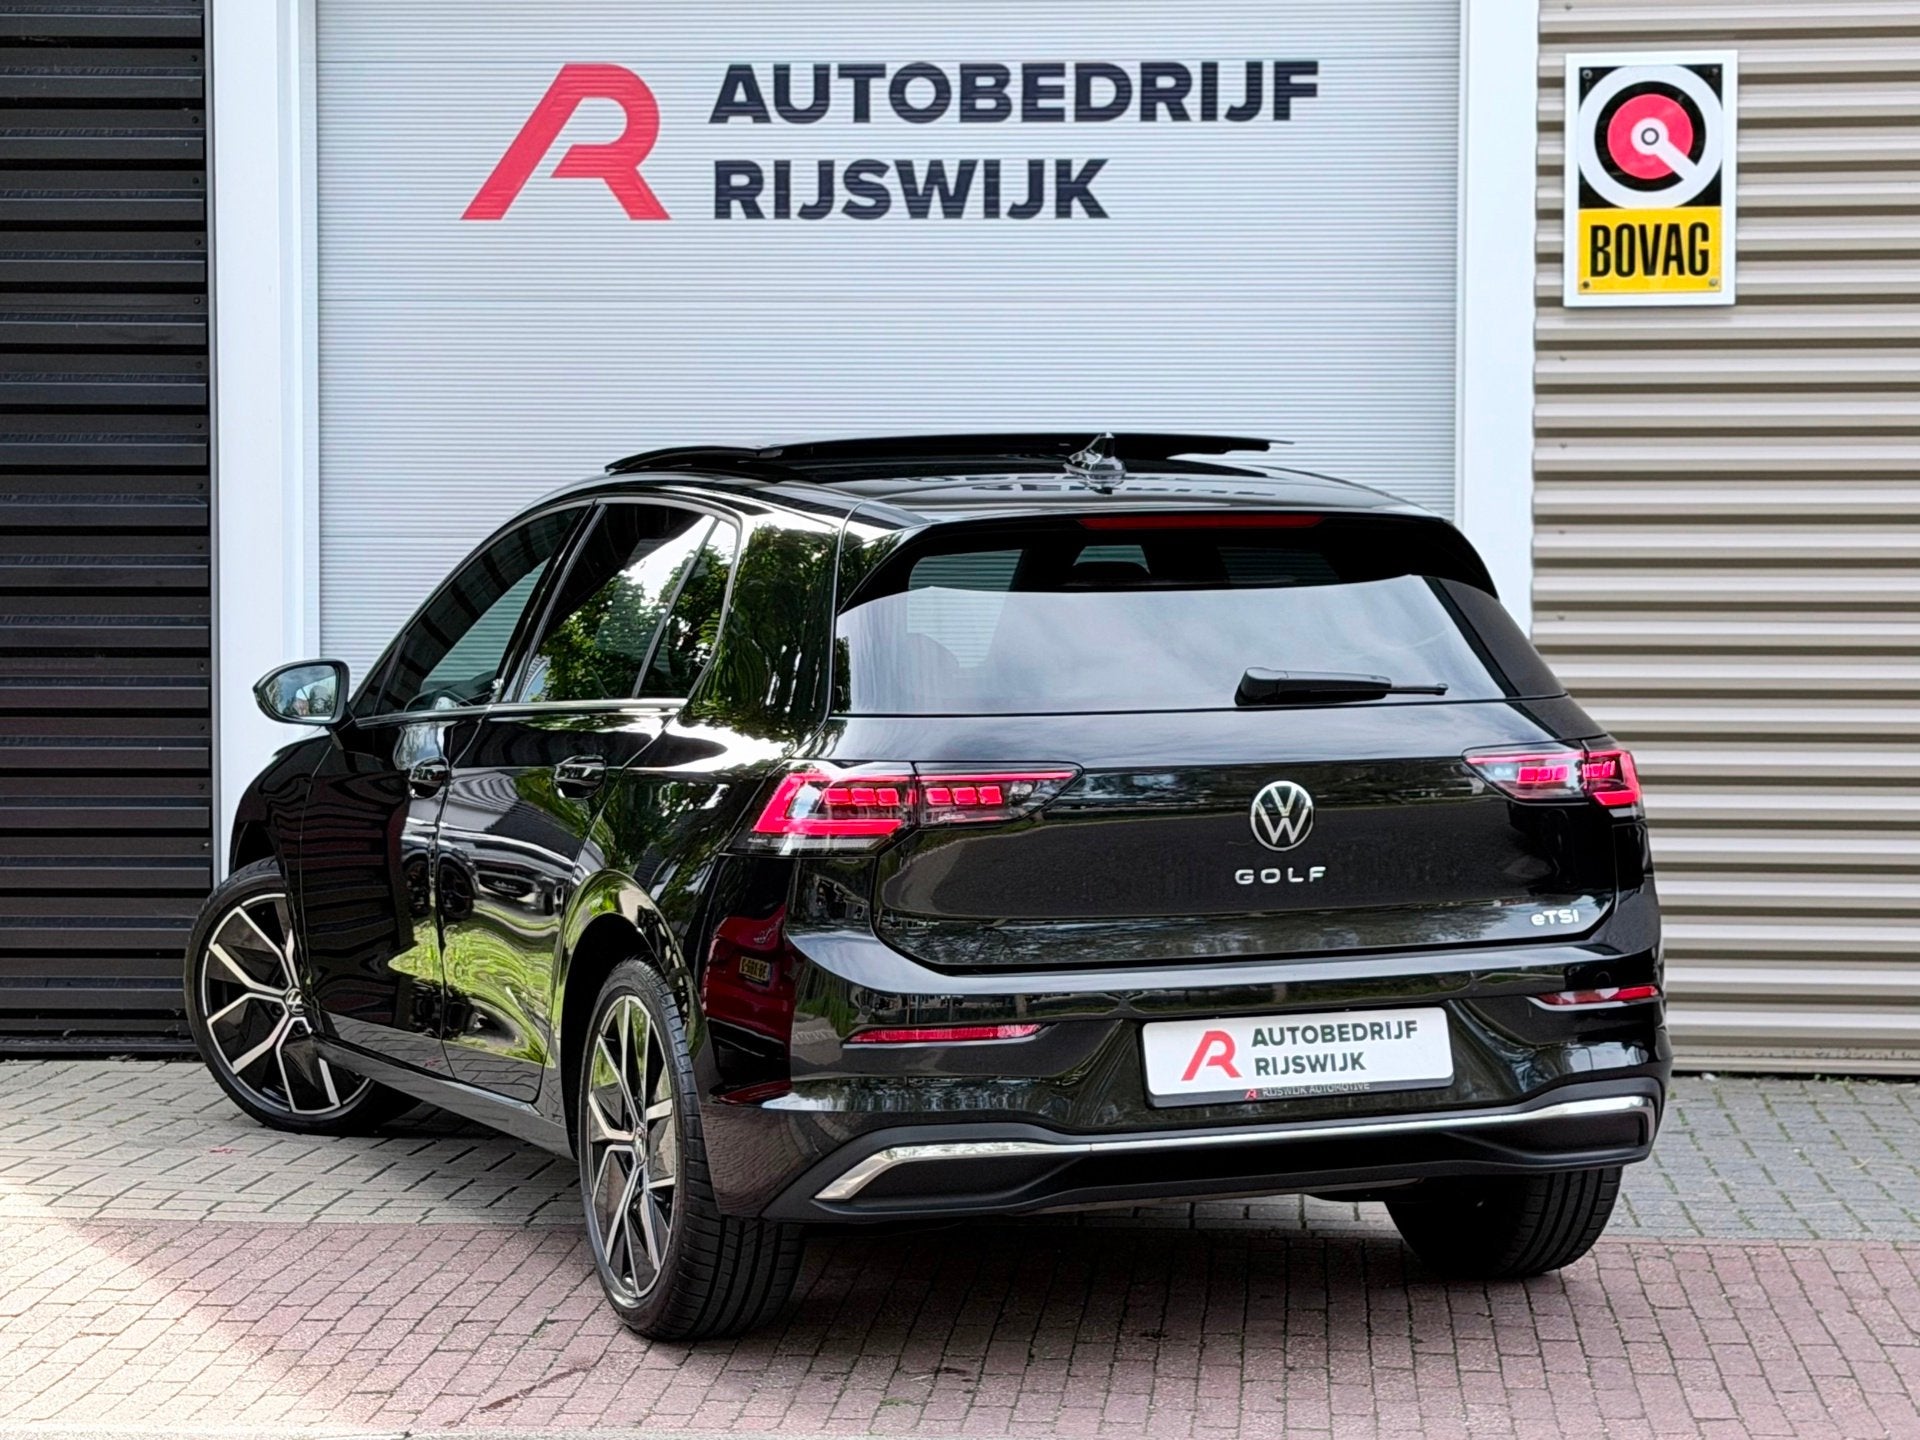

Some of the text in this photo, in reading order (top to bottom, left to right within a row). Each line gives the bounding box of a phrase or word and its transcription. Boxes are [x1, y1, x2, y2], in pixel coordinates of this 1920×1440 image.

[709, 61, 1318, 124] AUTOBEDRIJF
[714, 159, 1109, 220] RIJSWIJK
[1590, 222, 1710, 277] BOVAG
[1234, 866, 1326, 885] GOLF
[1531, 909, 1580, 926] eTSI
[1251, 1020, 1417, 1047] AUTOBEDRIJF
[1255, 1052, 1366, 1076] RIJSWIJK
